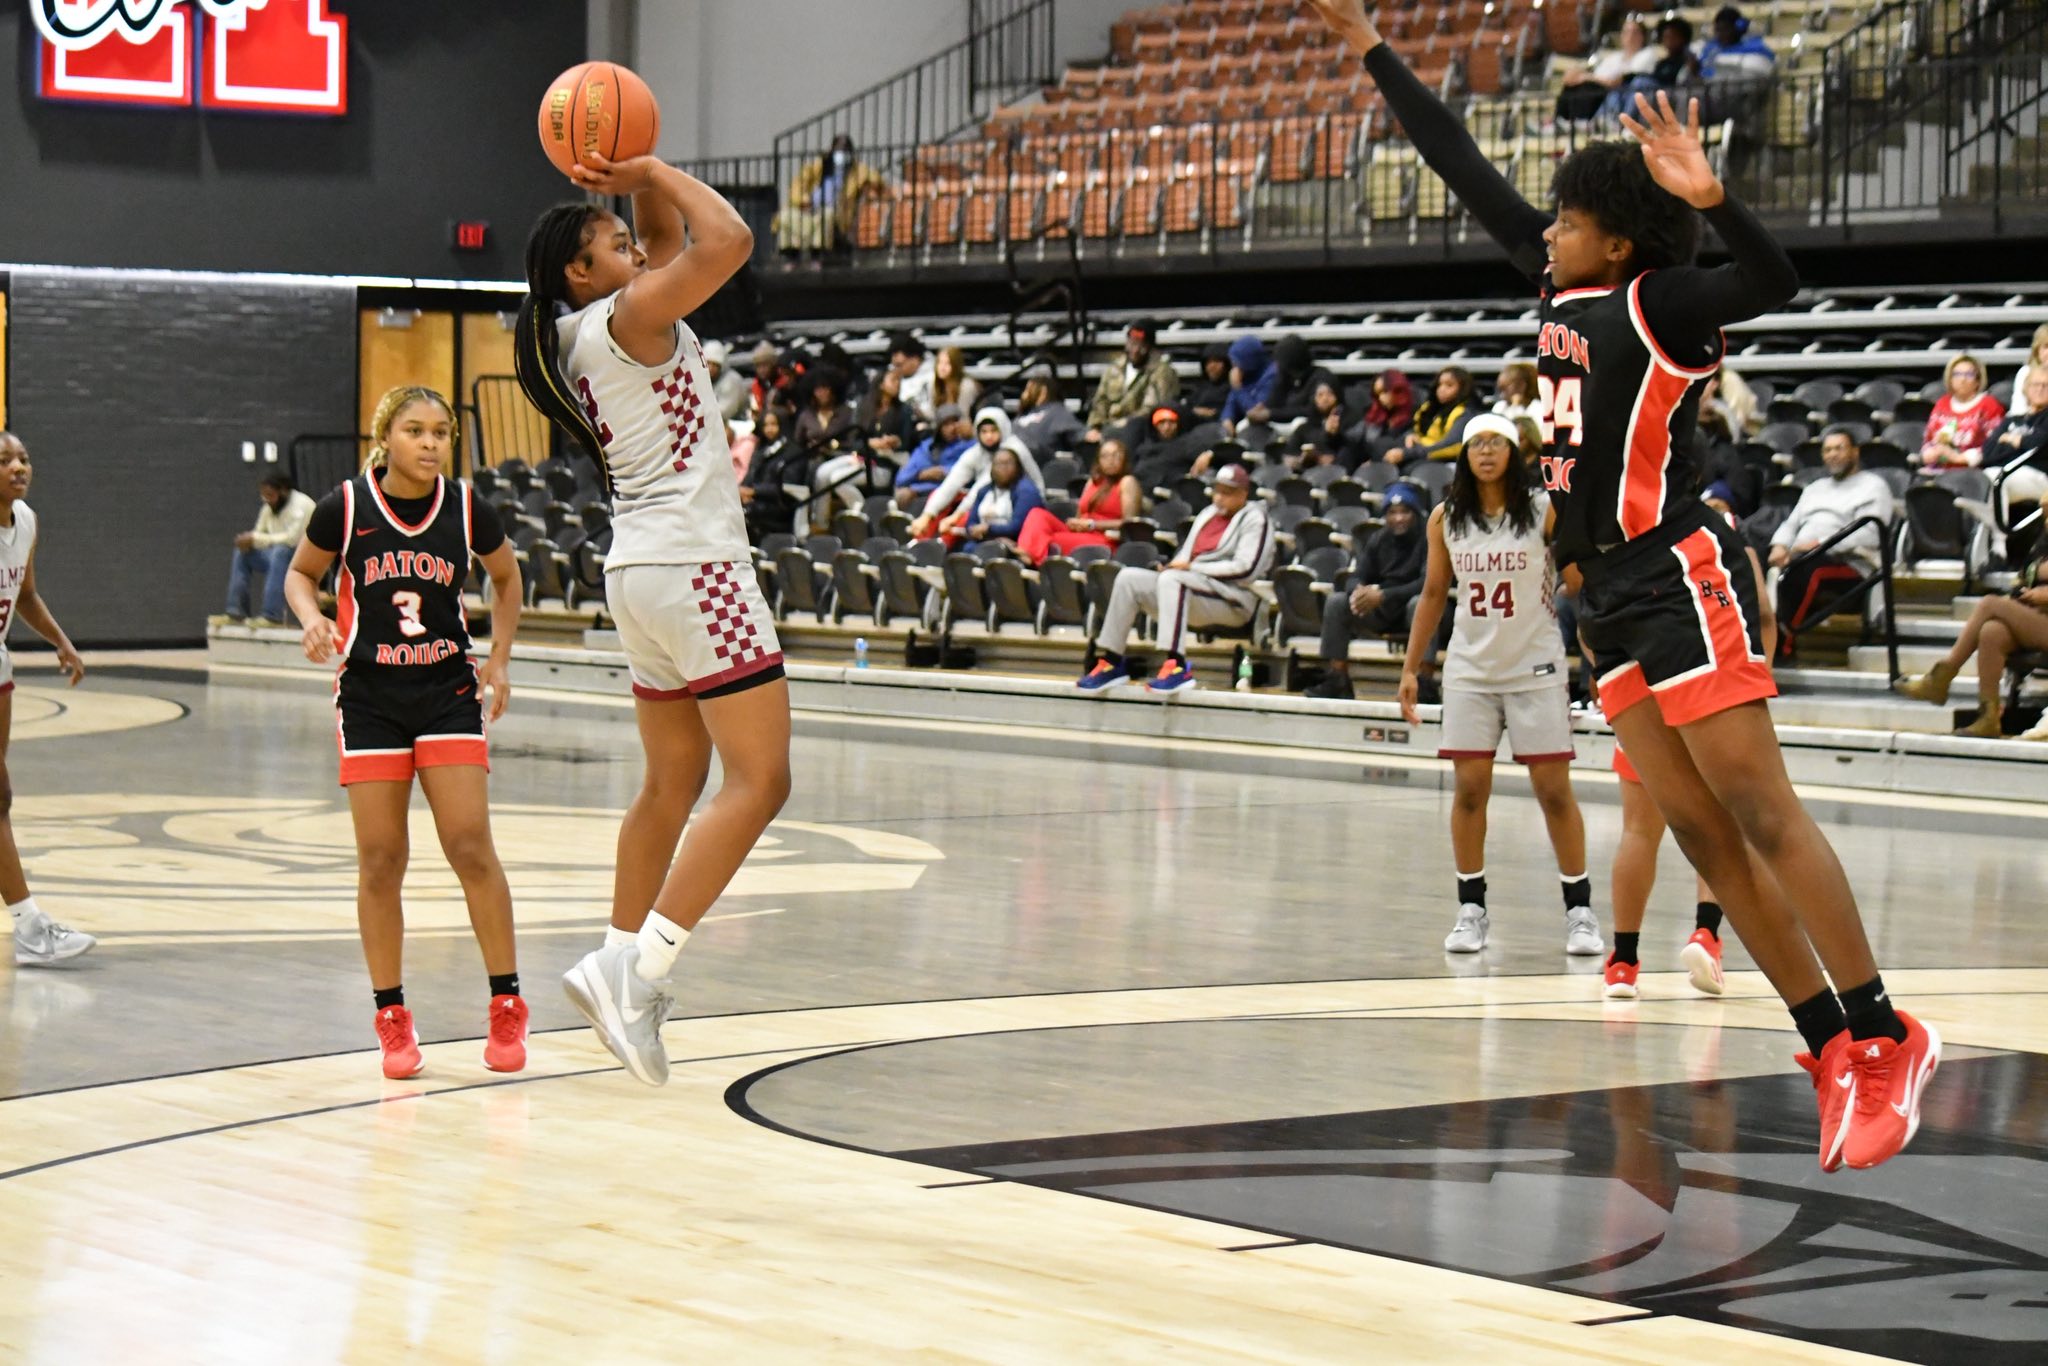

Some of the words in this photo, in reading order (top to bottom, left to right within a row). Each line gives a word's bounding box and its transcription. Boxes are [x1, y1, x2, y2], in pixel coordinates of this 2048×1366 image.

[1537, 375, 1583, 446] 24
[364, 550, 455, 587] BATON
[1454, 552, 1527, 573] HOLMES
[392, 590, 427, 637] 3
[1469, 580, 1515, 618] 24
